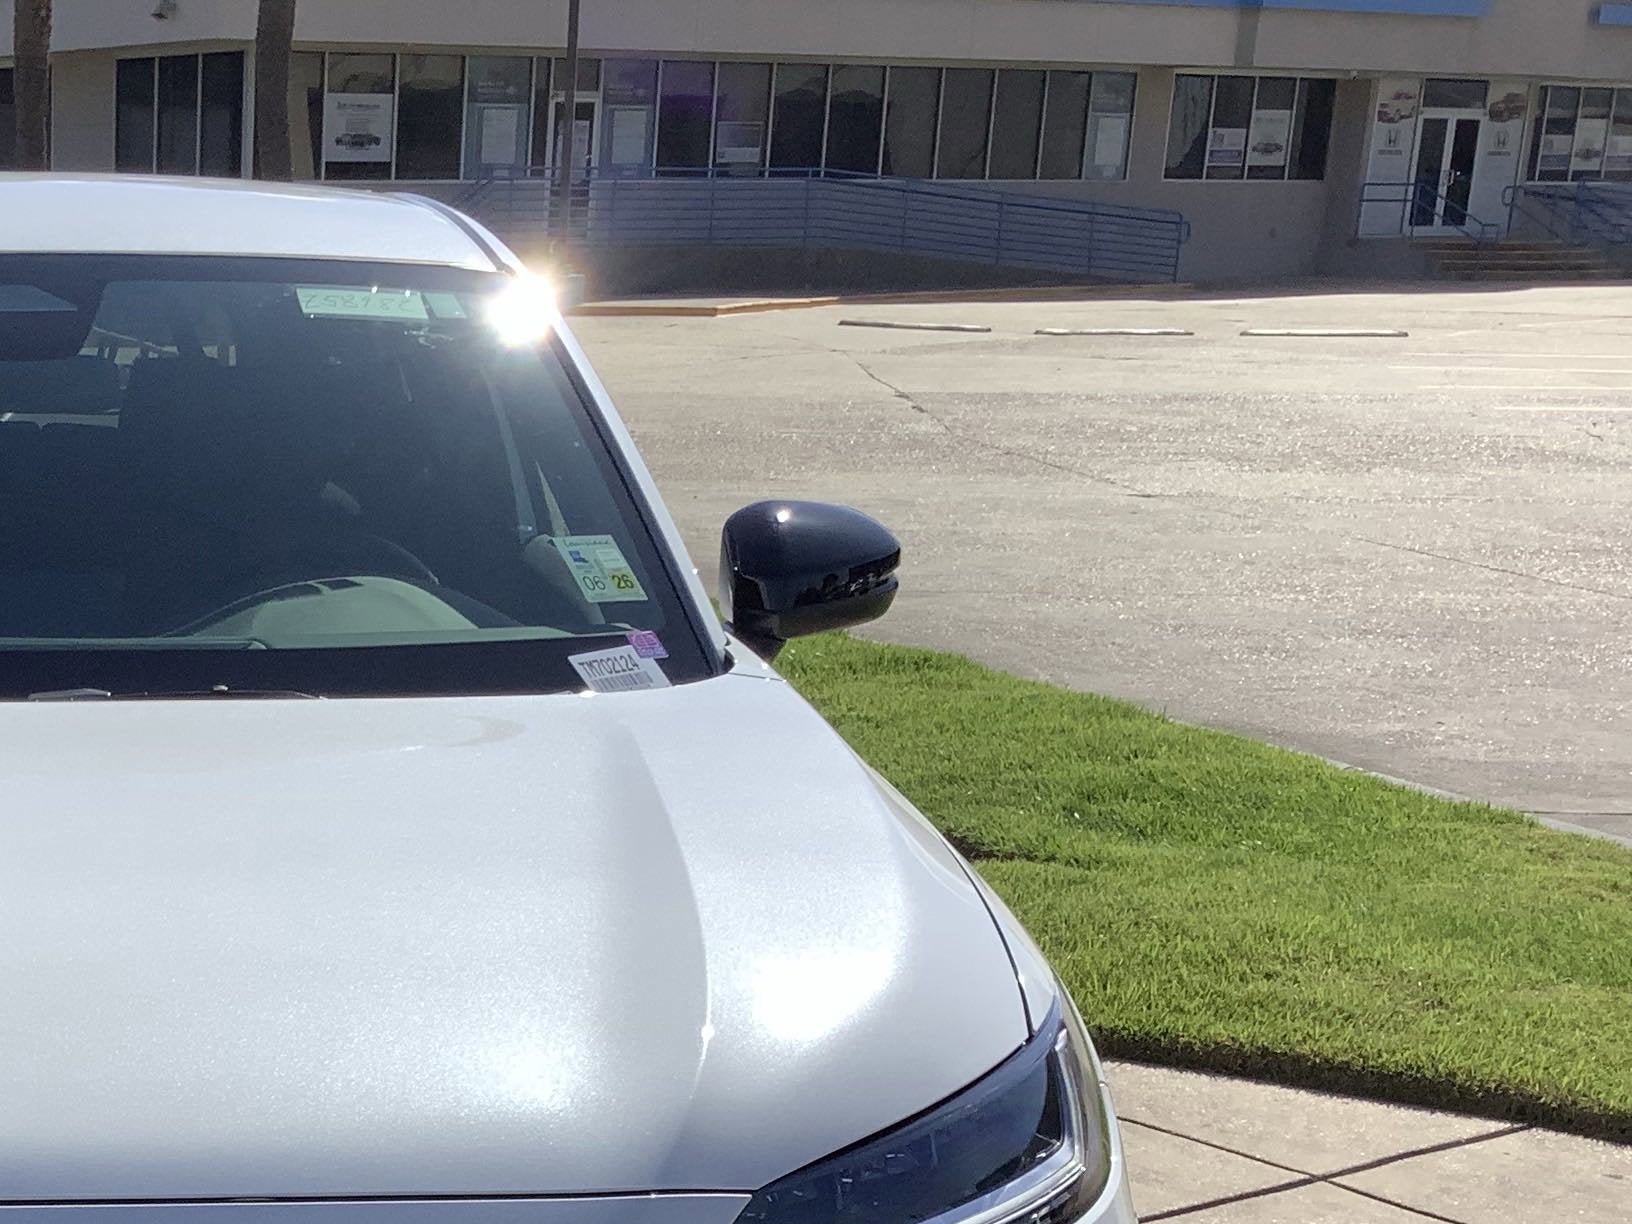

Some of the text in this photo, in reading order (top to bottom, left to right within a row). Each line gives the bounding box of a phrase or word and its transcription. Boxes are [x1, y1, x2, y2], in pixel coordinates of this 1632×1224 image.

[582, 574, 635, 591] 06 26
[577, 654, 640, 679] TM702124
